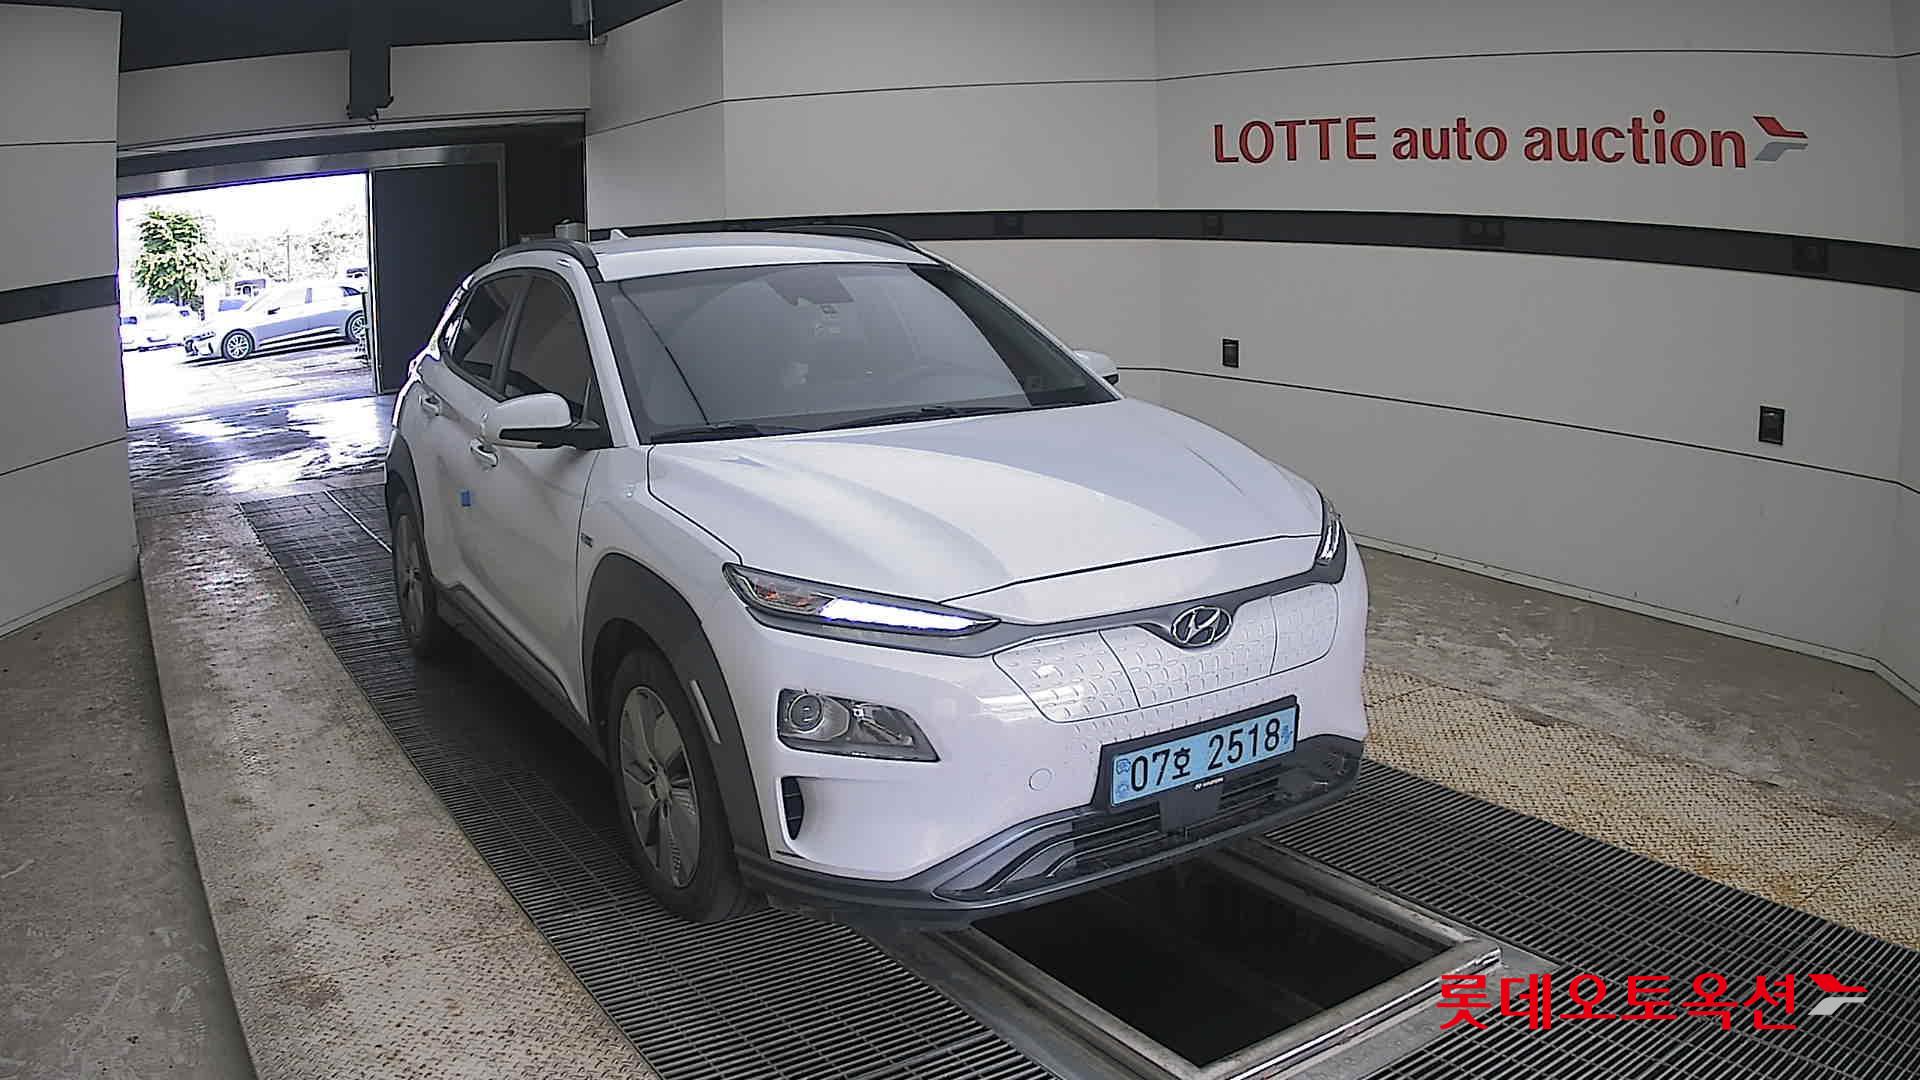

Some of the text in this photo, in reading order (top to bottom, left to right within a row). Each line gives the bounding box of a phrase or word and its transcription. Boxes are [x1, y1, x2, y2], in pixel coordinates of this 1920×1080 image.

[1213, 109, 1747, 168] LOTTE auto auction
[1130, 717, 1281, 792] 07호 2518
